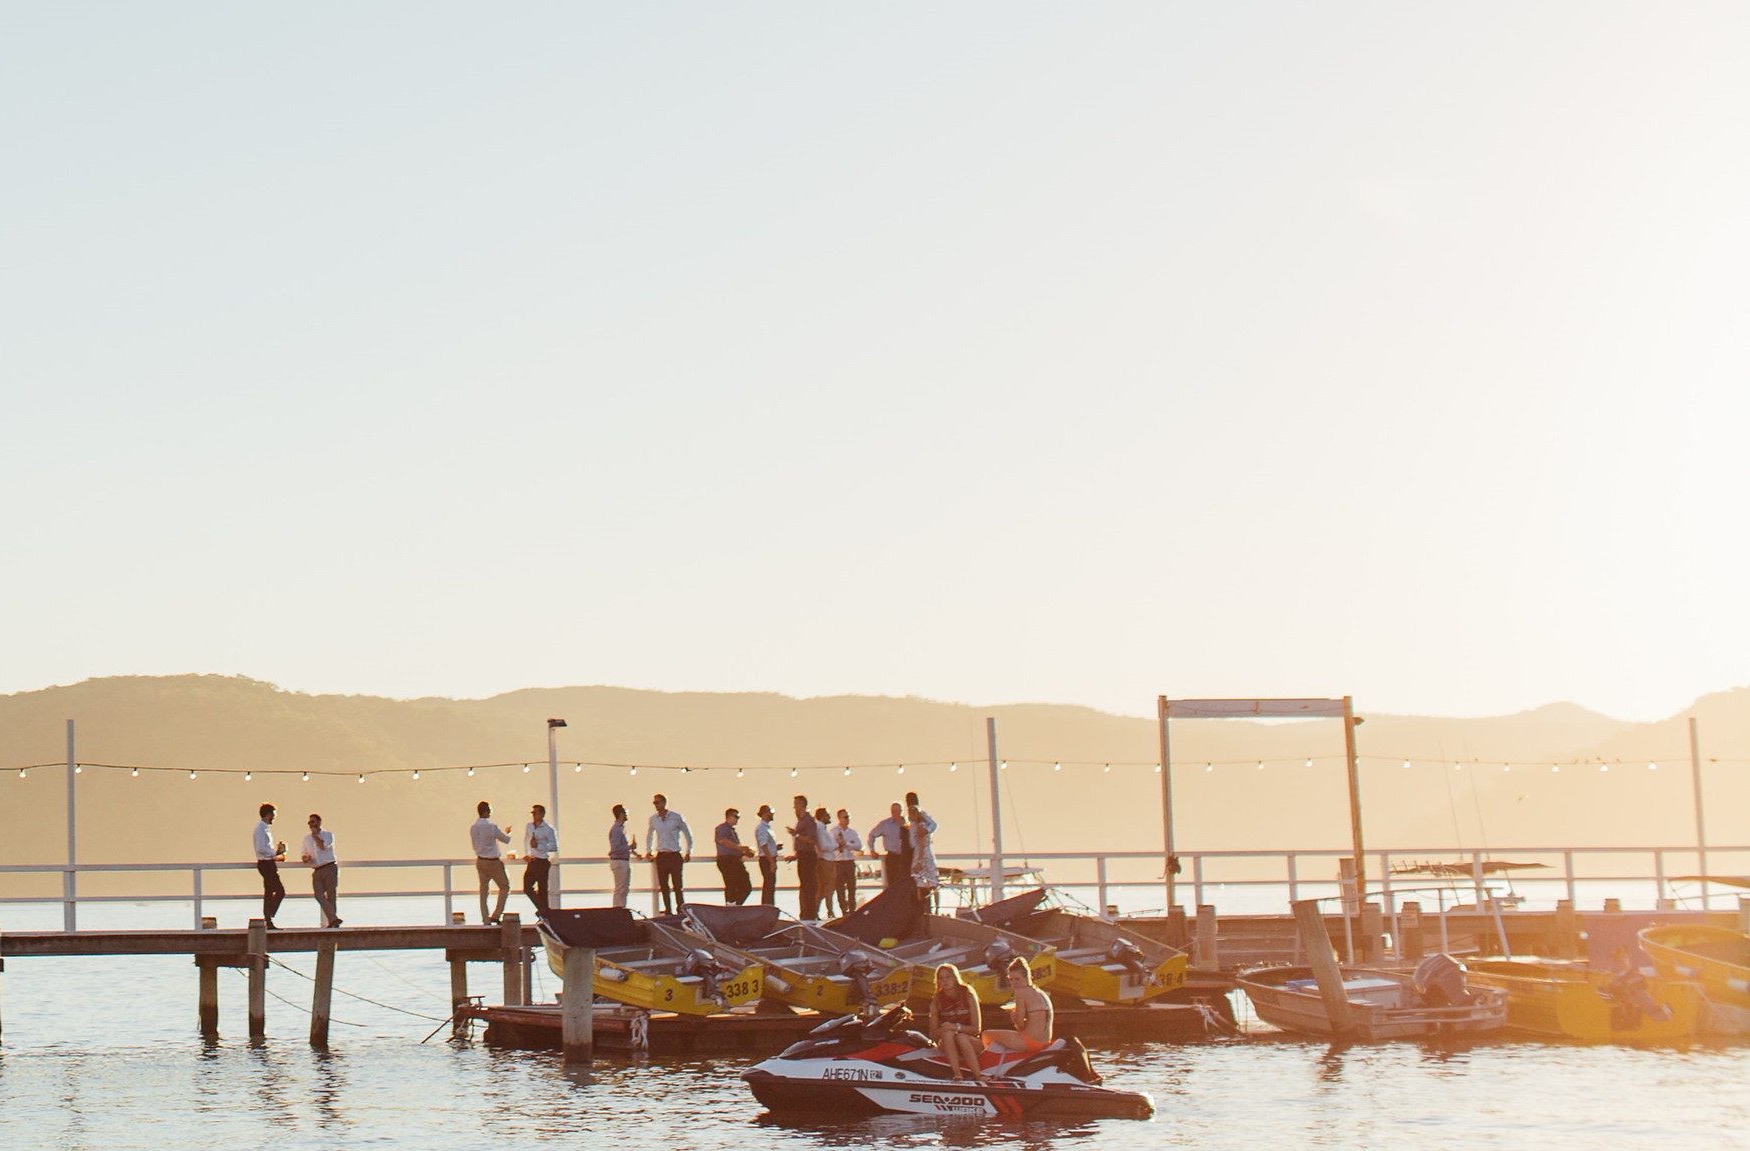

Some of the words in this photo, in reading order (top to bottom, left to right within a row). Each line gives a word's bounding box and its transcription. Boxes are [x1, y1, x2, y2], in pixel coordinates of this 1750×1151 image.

[665, 988, 673, 1001] 3
[816, 984, 823, 996] 2
[822, 1067, 868, 1081] AHE671N
